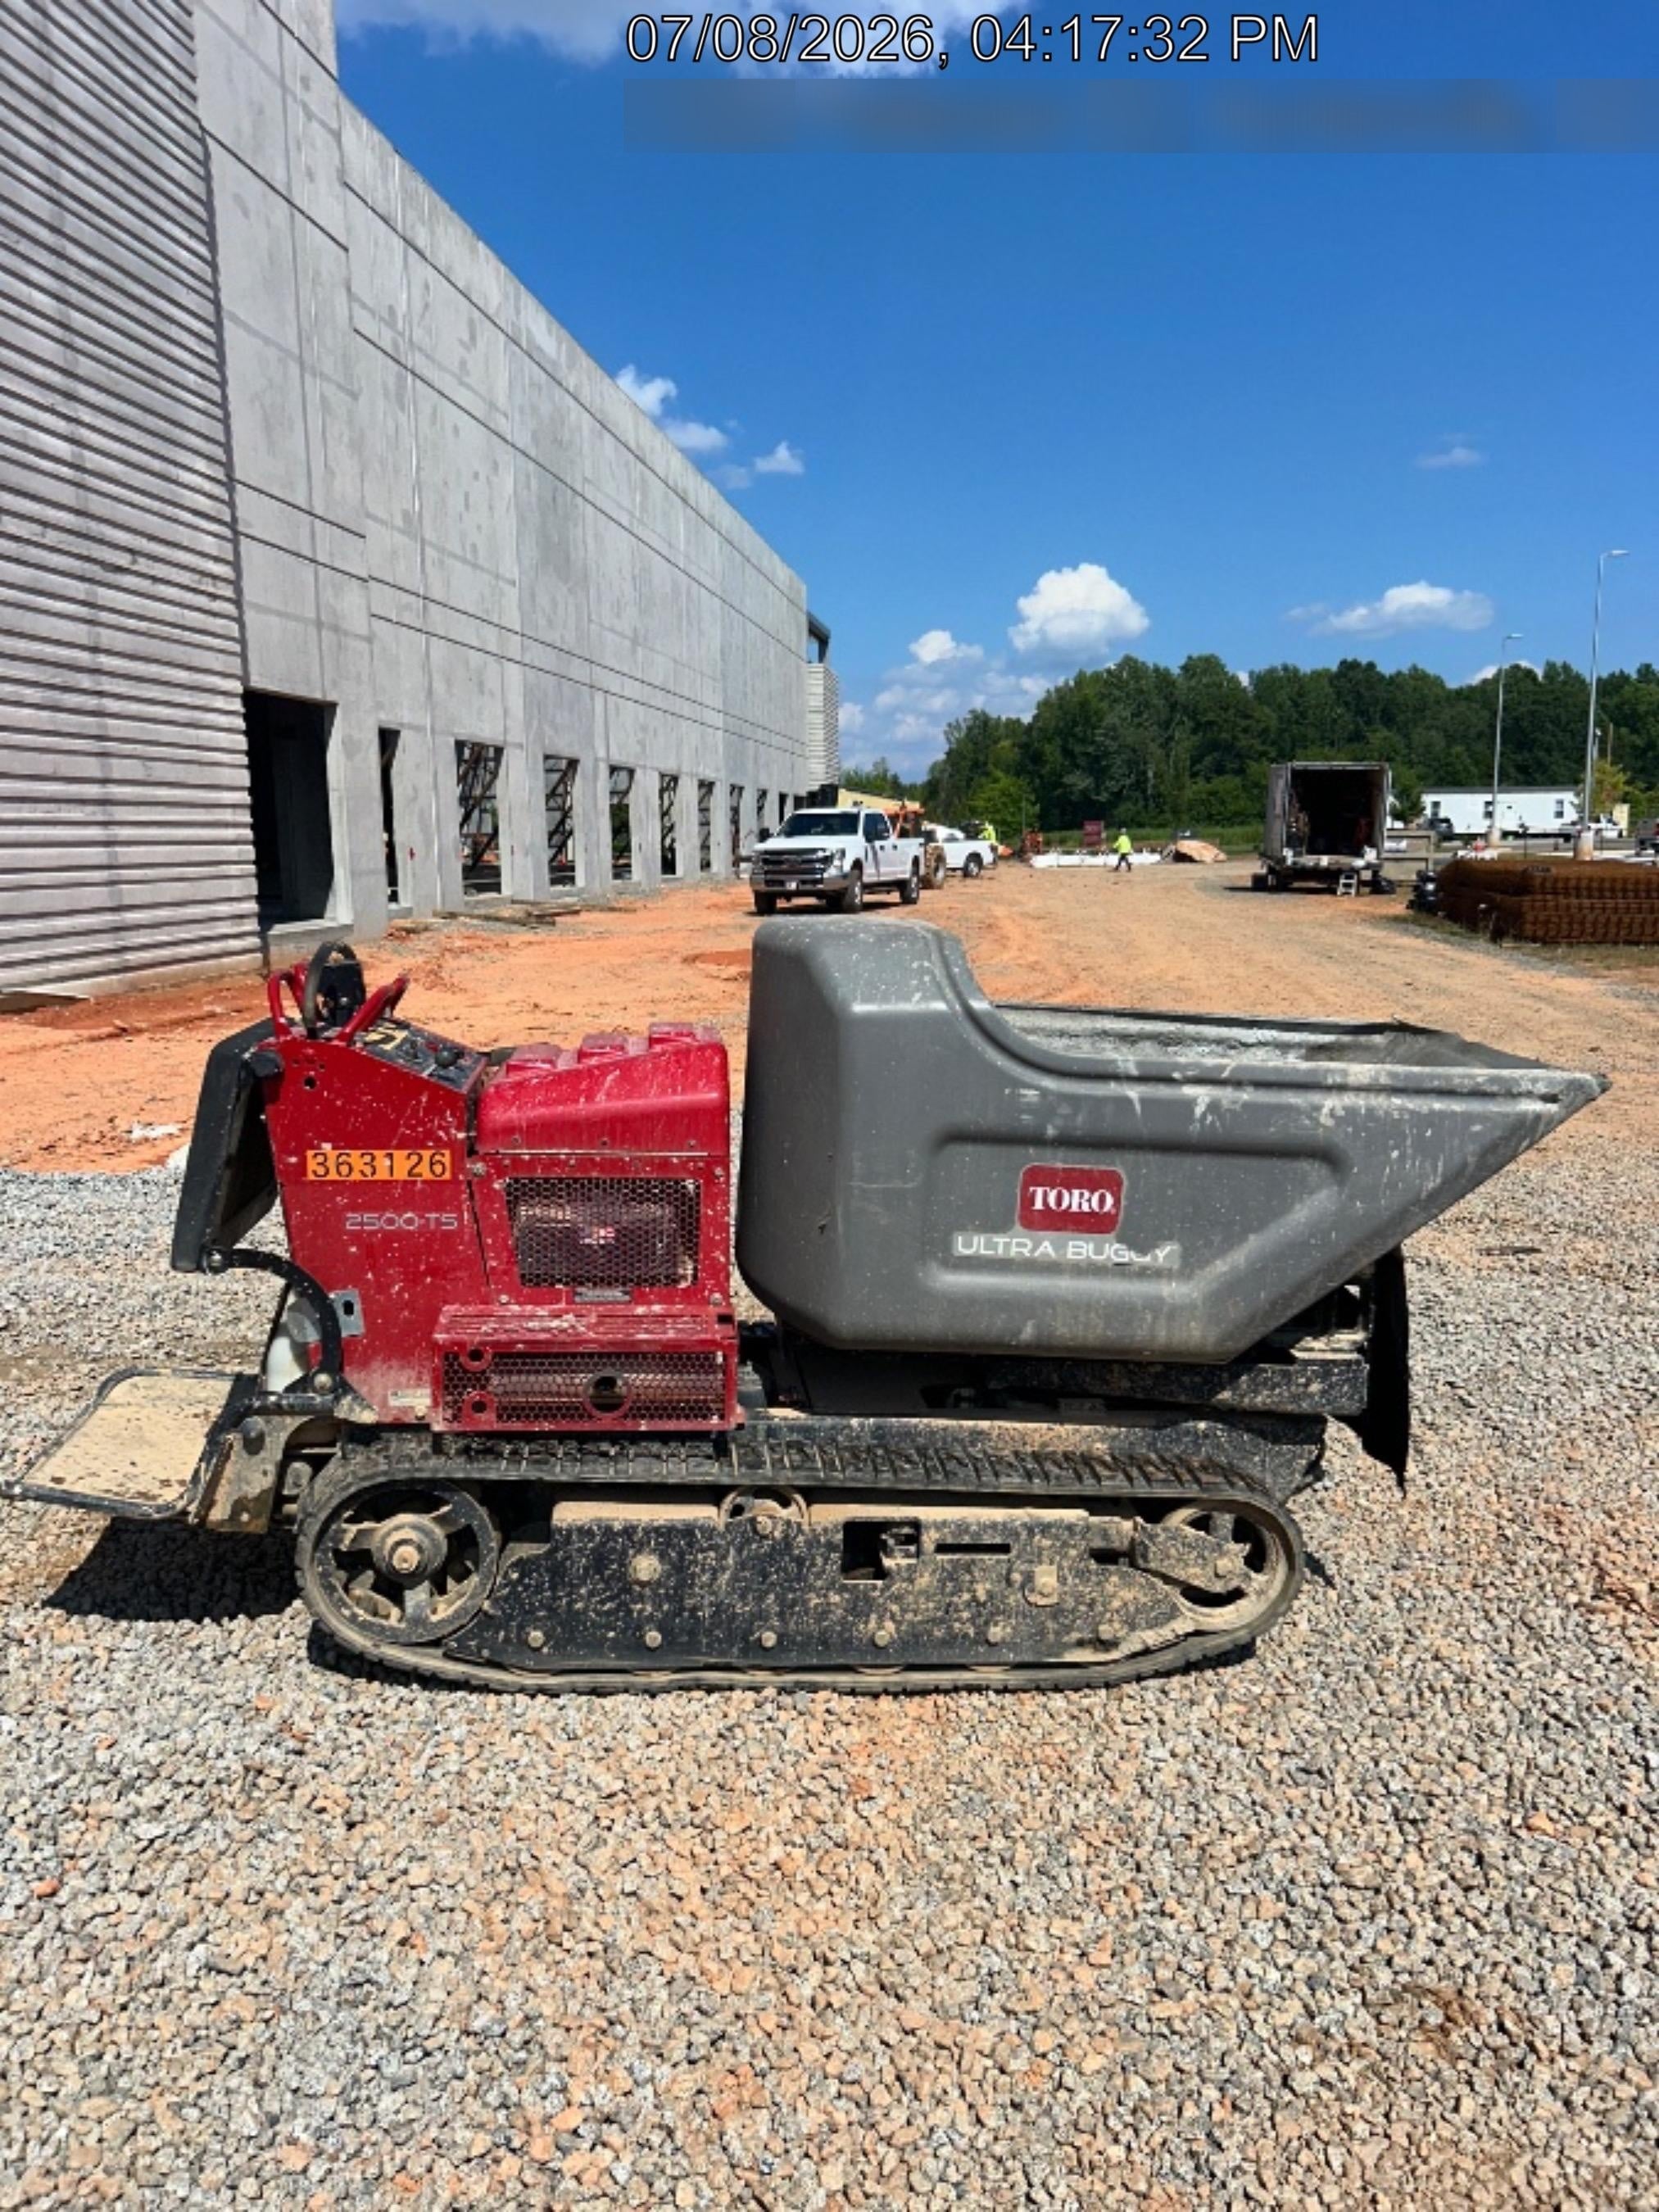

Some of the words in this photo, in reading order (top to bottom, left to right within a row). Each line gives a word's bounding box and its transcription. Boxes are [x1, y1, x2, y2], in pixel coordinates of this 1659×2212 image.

[310, 1152, 446, 1178] 363126
[1028, 1186, 1115, 1214] TORO
[345, 1213, 459, 1231] 2500-TS
[957, 1235, 1056, 1258] ULTRA
